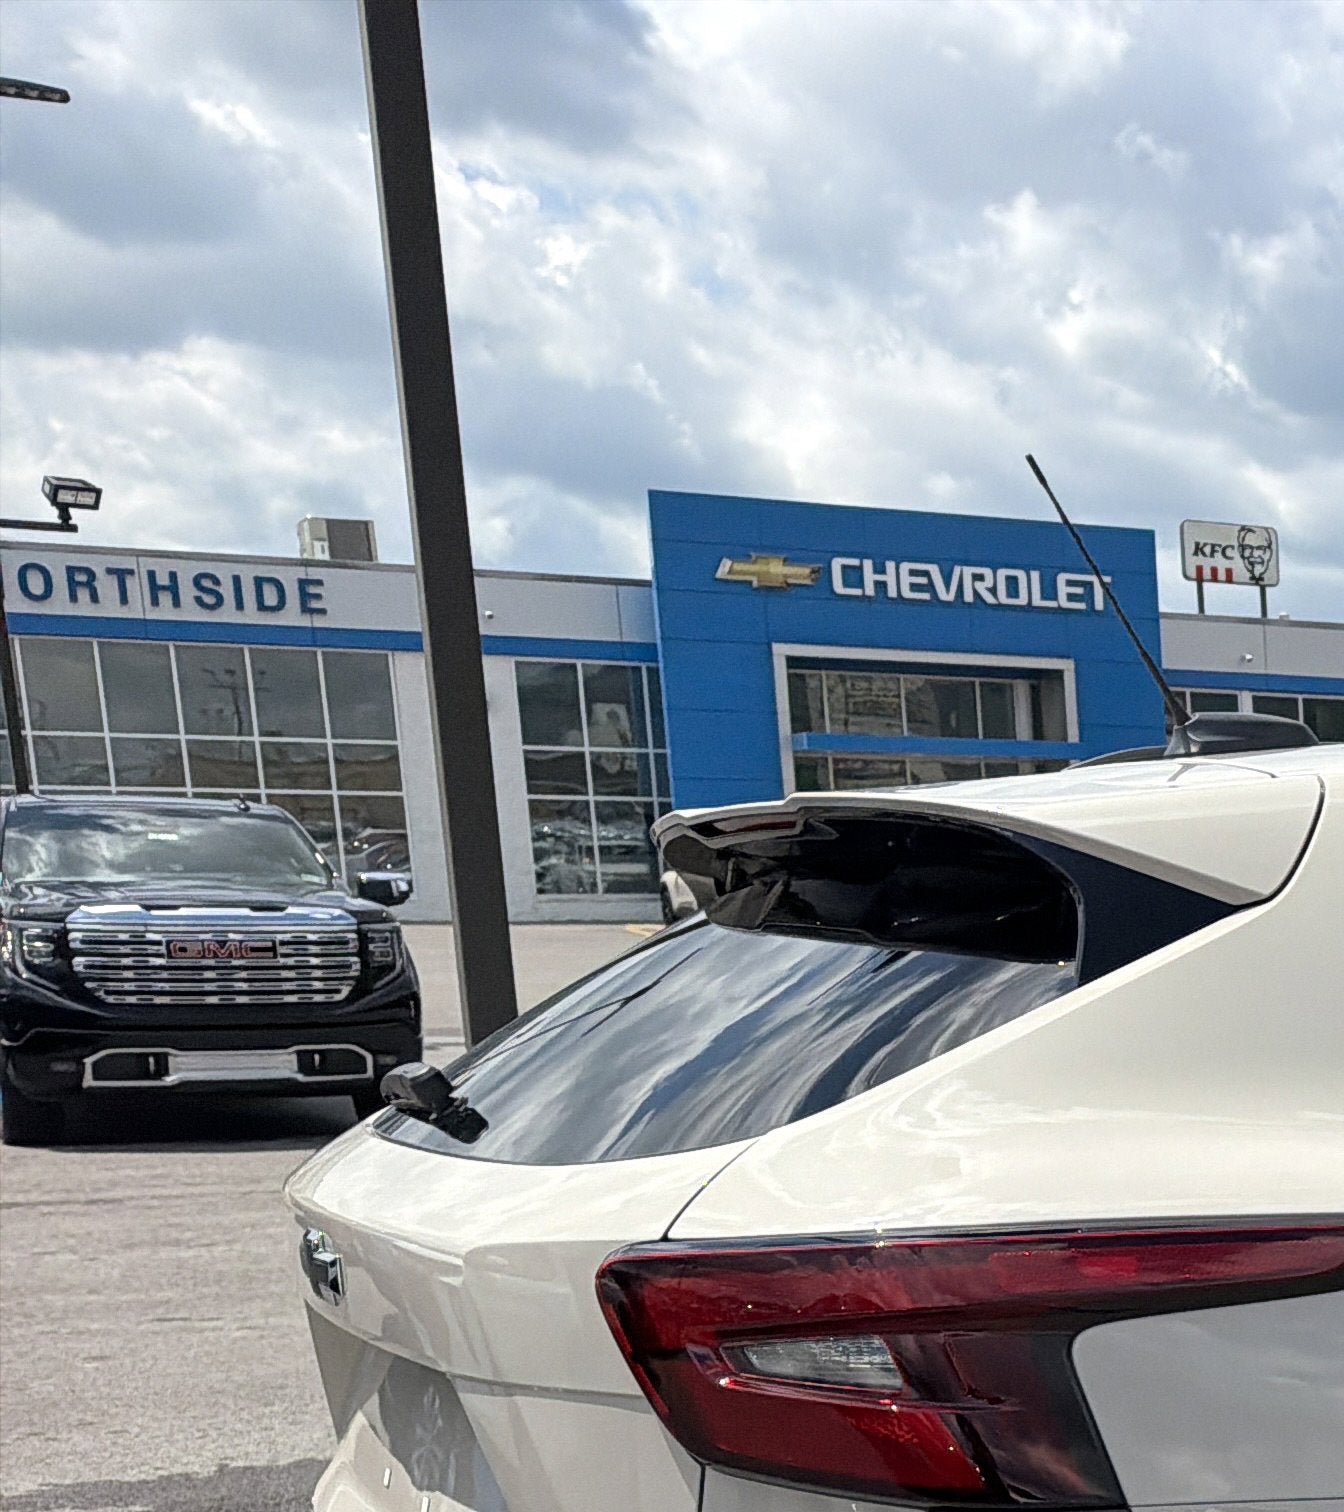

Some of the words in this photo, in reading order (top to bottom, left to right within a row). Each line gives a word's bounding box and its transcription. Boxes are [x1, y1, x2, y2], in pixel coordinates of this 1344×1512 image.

[1192, 541, 1236, 561] KFC
[17, 562, 328, 616] ORTHSIDE
[831, 556, 1112, 612] CHEVROLET
[169, 941, 275, 959] GMC
